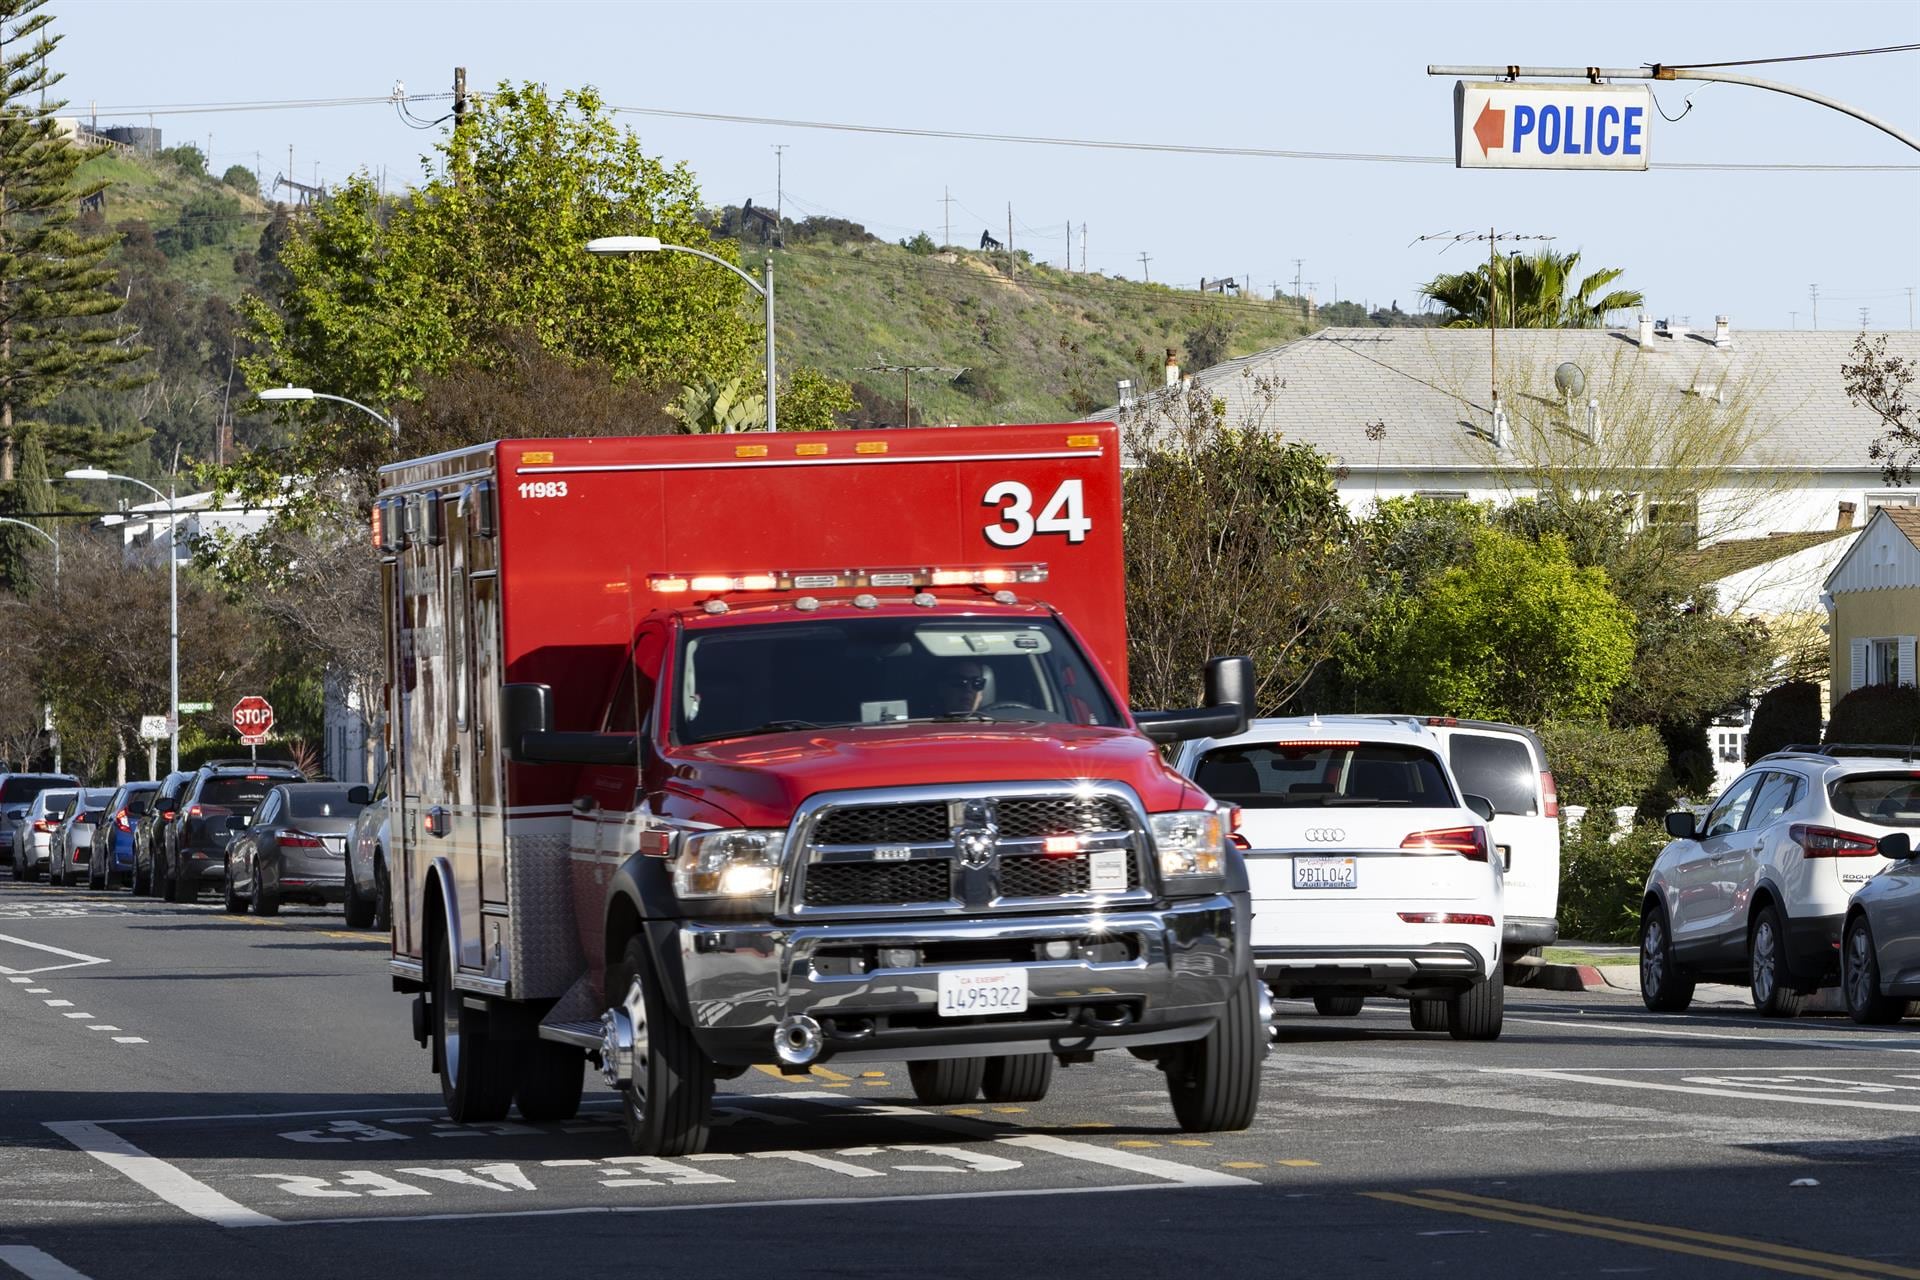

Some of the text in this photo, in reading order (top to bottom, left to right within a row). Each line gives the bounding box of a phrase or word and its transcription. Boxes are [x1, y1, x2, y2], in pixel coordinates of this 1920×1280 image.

[1512, 104, 1643, 155] POLICE
[518, 481, 568, 498] 11983
[983, 479, 1092, 547] 34
[235, 709, 270, 724] STOP
[1299, 868, 1352, 882] 9BIL042
[975, 975, 1005, 983] EXEMPT
[946, 986, 1020, 1009] 1495322
